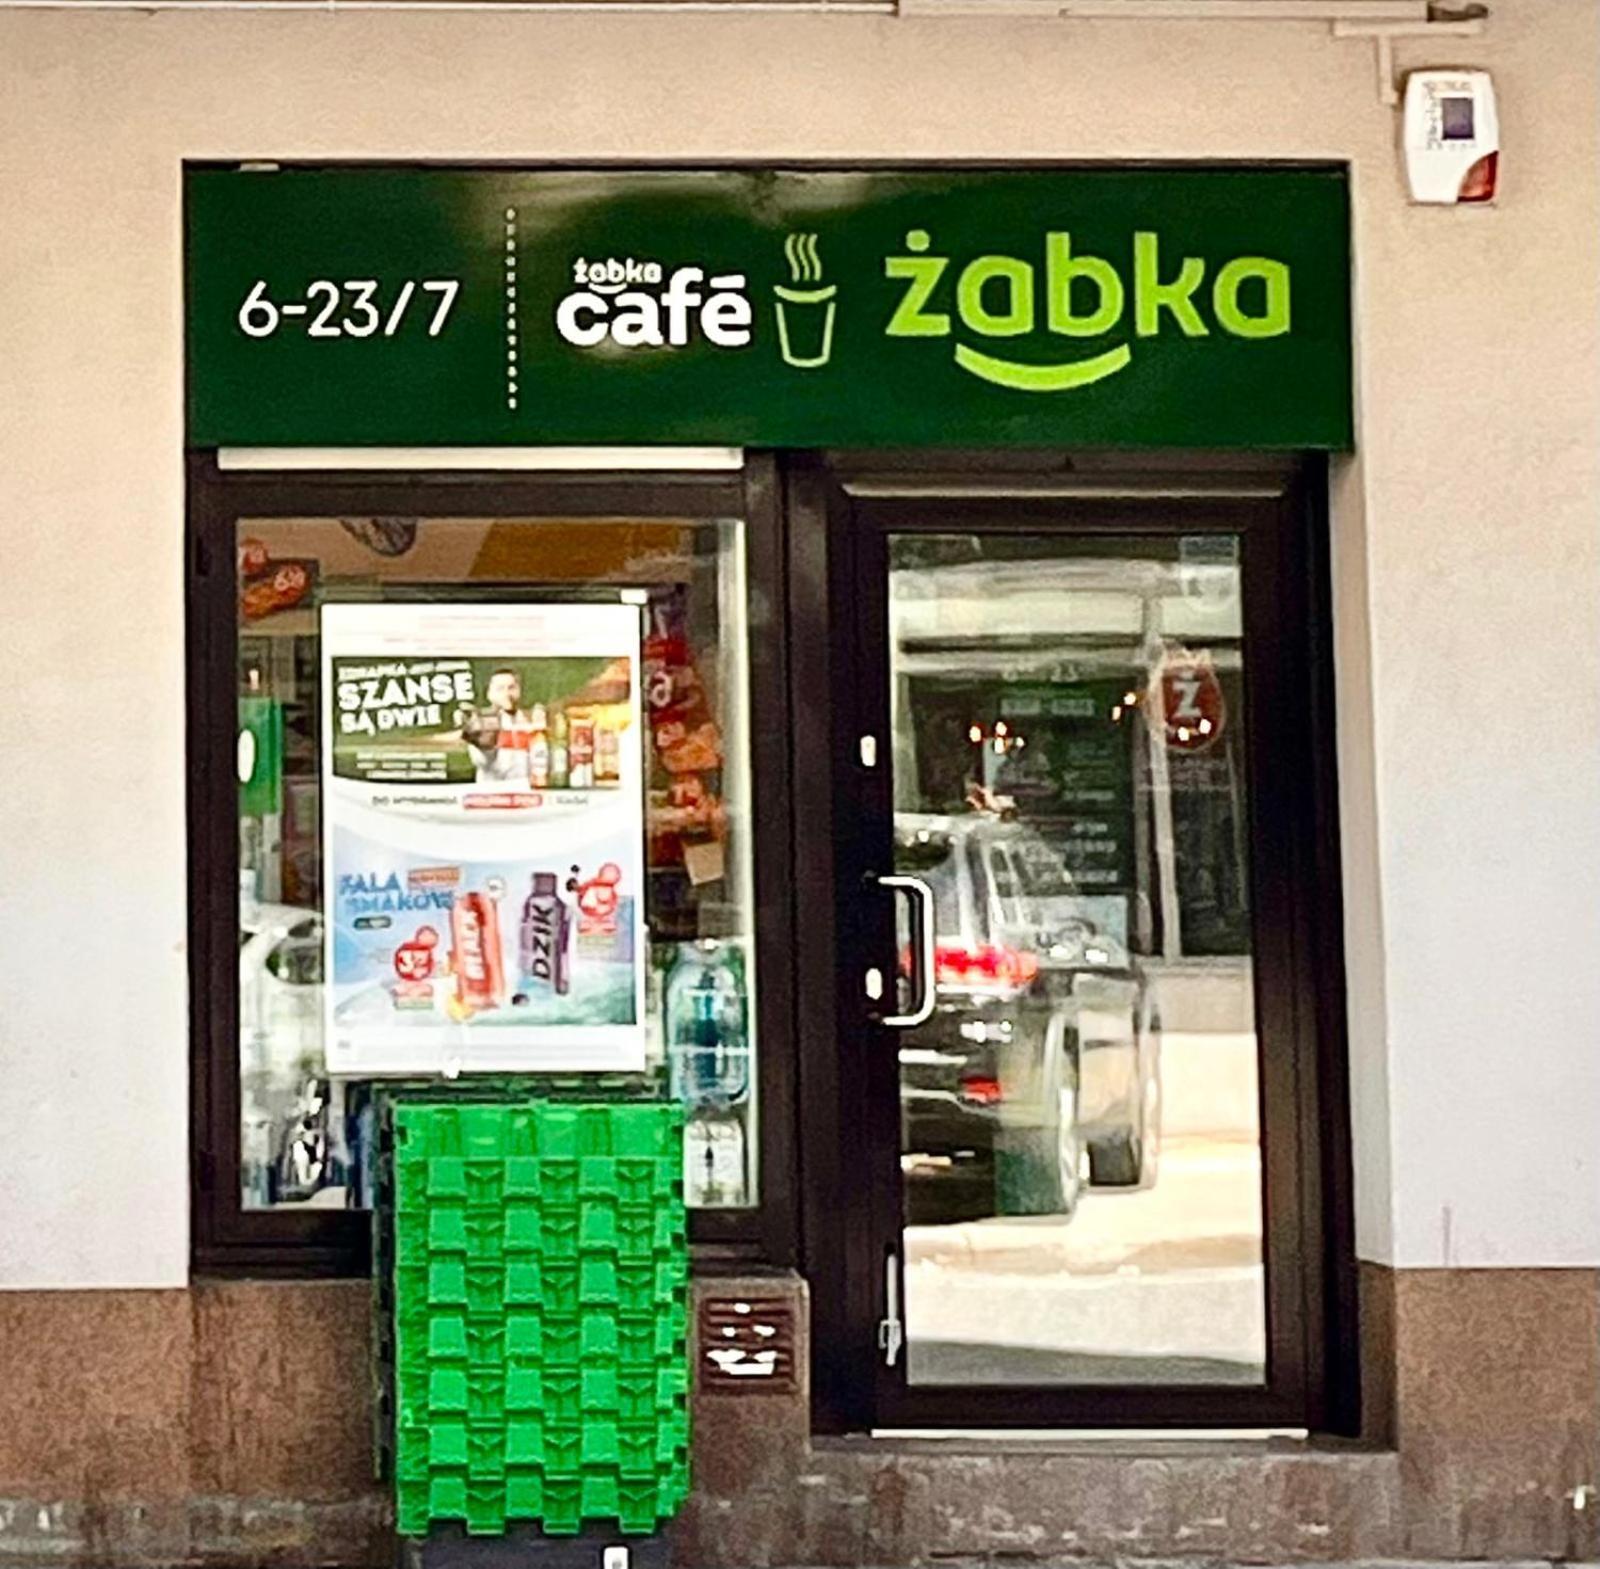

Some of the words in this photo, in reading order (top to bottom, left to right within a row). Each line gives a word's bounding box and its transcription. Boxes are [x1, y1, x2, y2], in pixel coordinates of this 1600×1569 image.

[238, 280, 460, 338] 6-23/7
[558, 267, 752, 347] café
[885, 230, 1291, 338] żabka
[337, 671, 475, 711] SZANSE
[532, 904, 553, 979] DZIK
